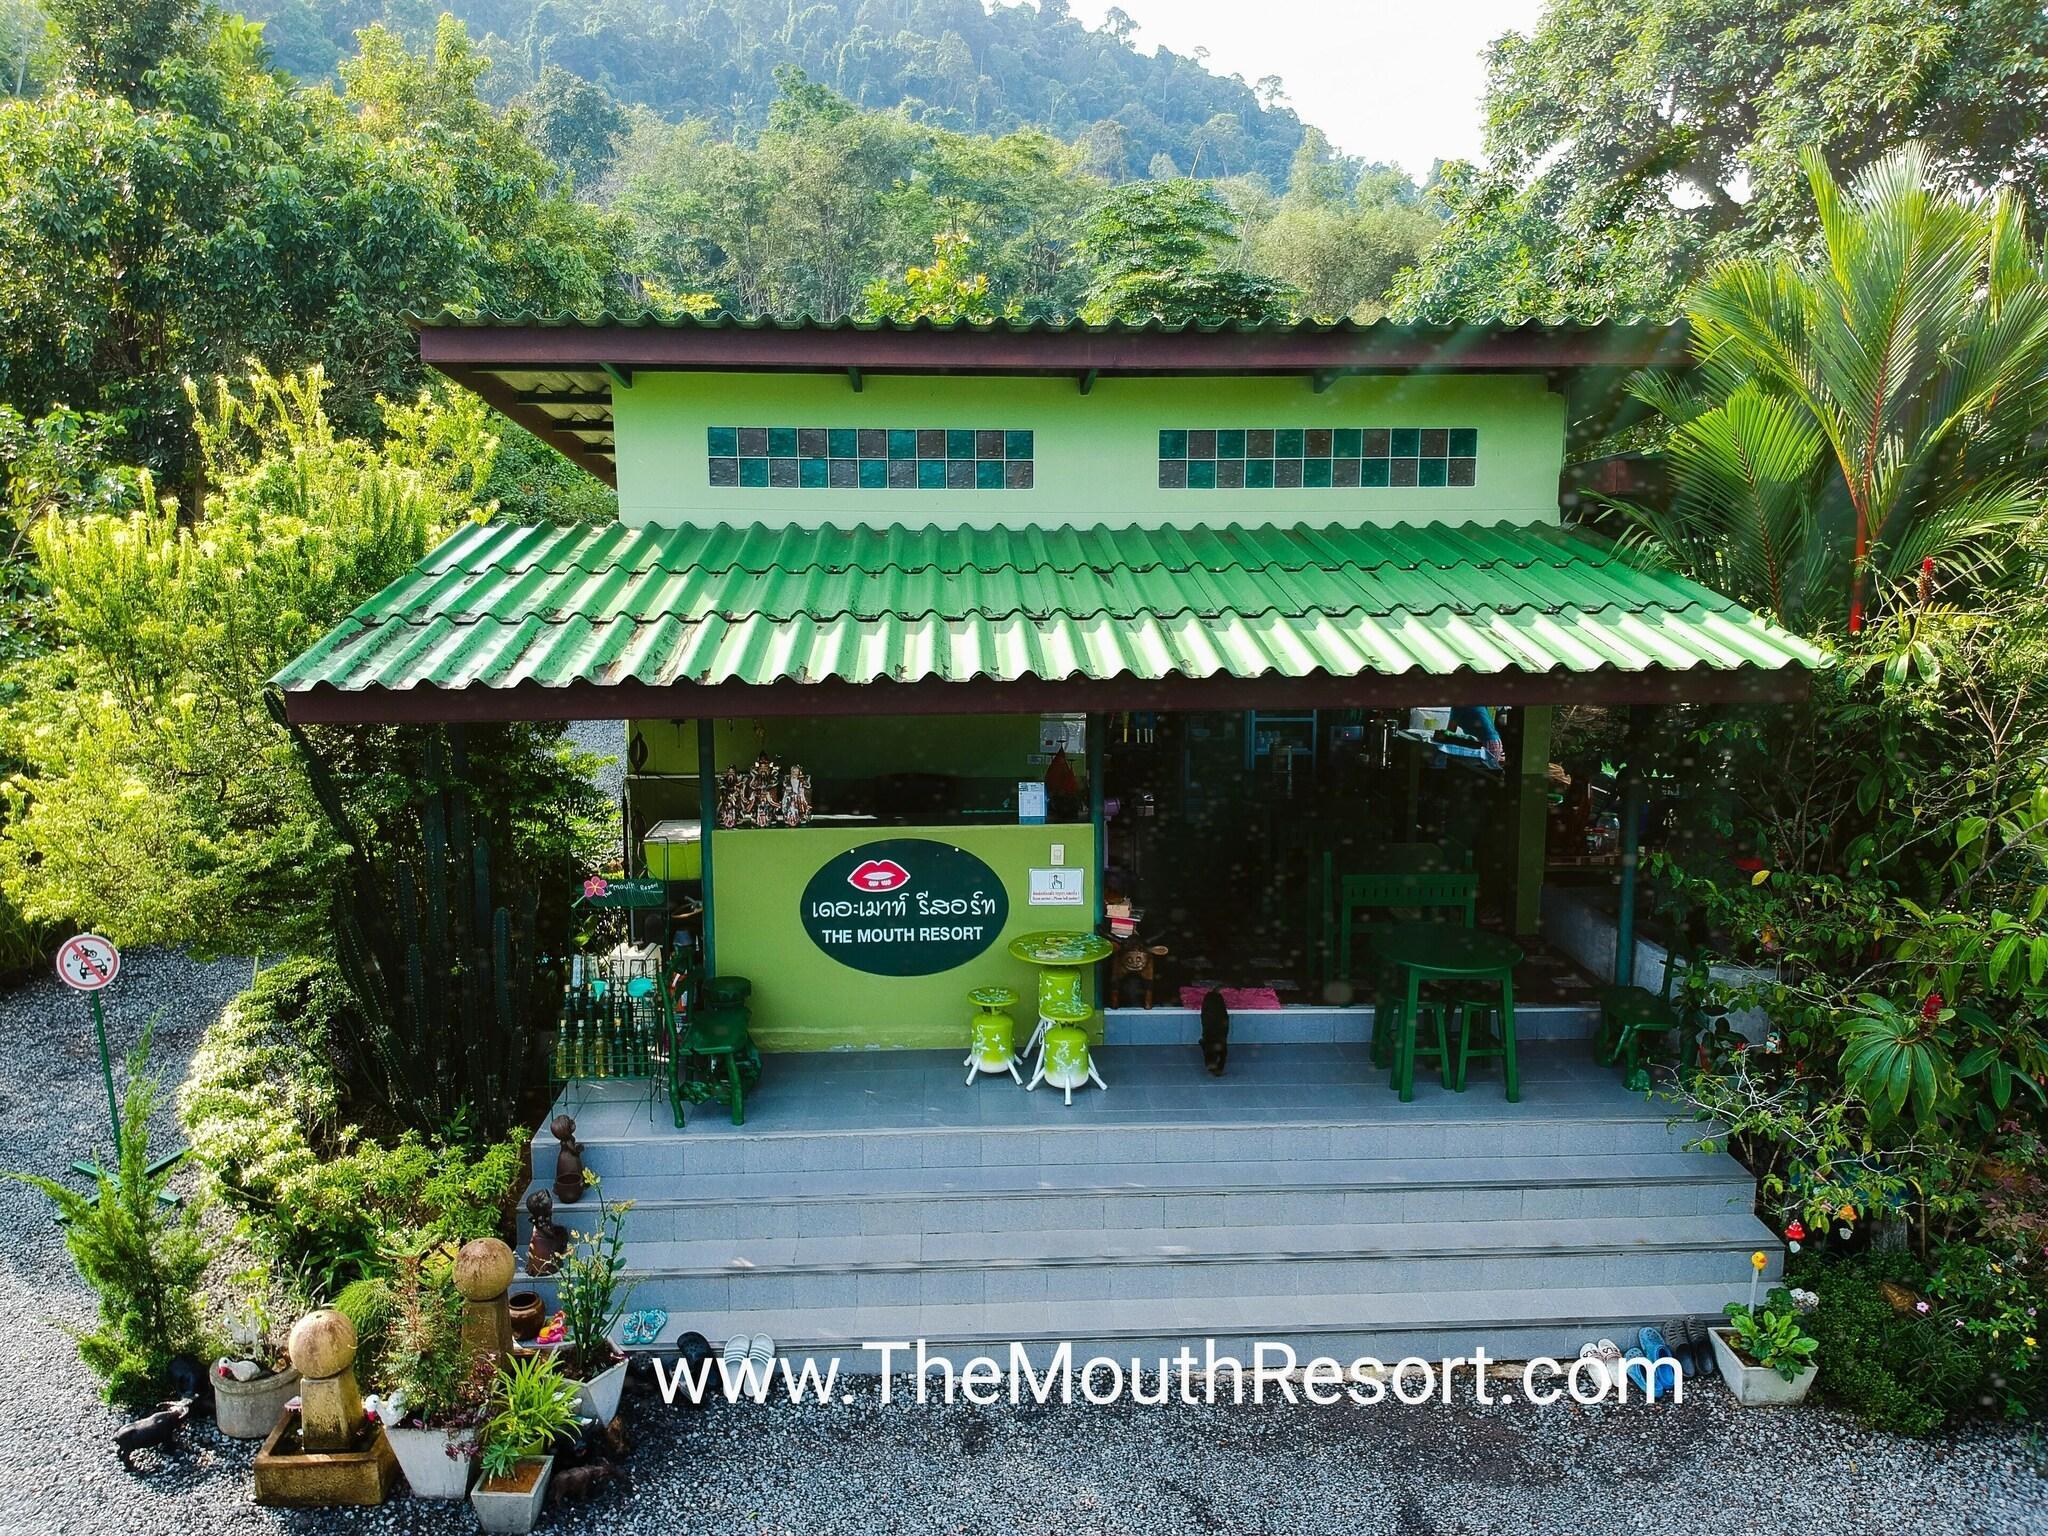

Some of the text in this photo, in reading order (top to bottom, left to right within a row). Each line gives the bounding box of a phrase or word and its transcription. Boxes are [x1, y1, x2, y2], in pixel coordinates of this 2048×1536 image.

[812, 891, 996, 918] เดอะเมาท์ รีสอร์ท
[821, 926, 984, 944] THE MOUTH RESORT
